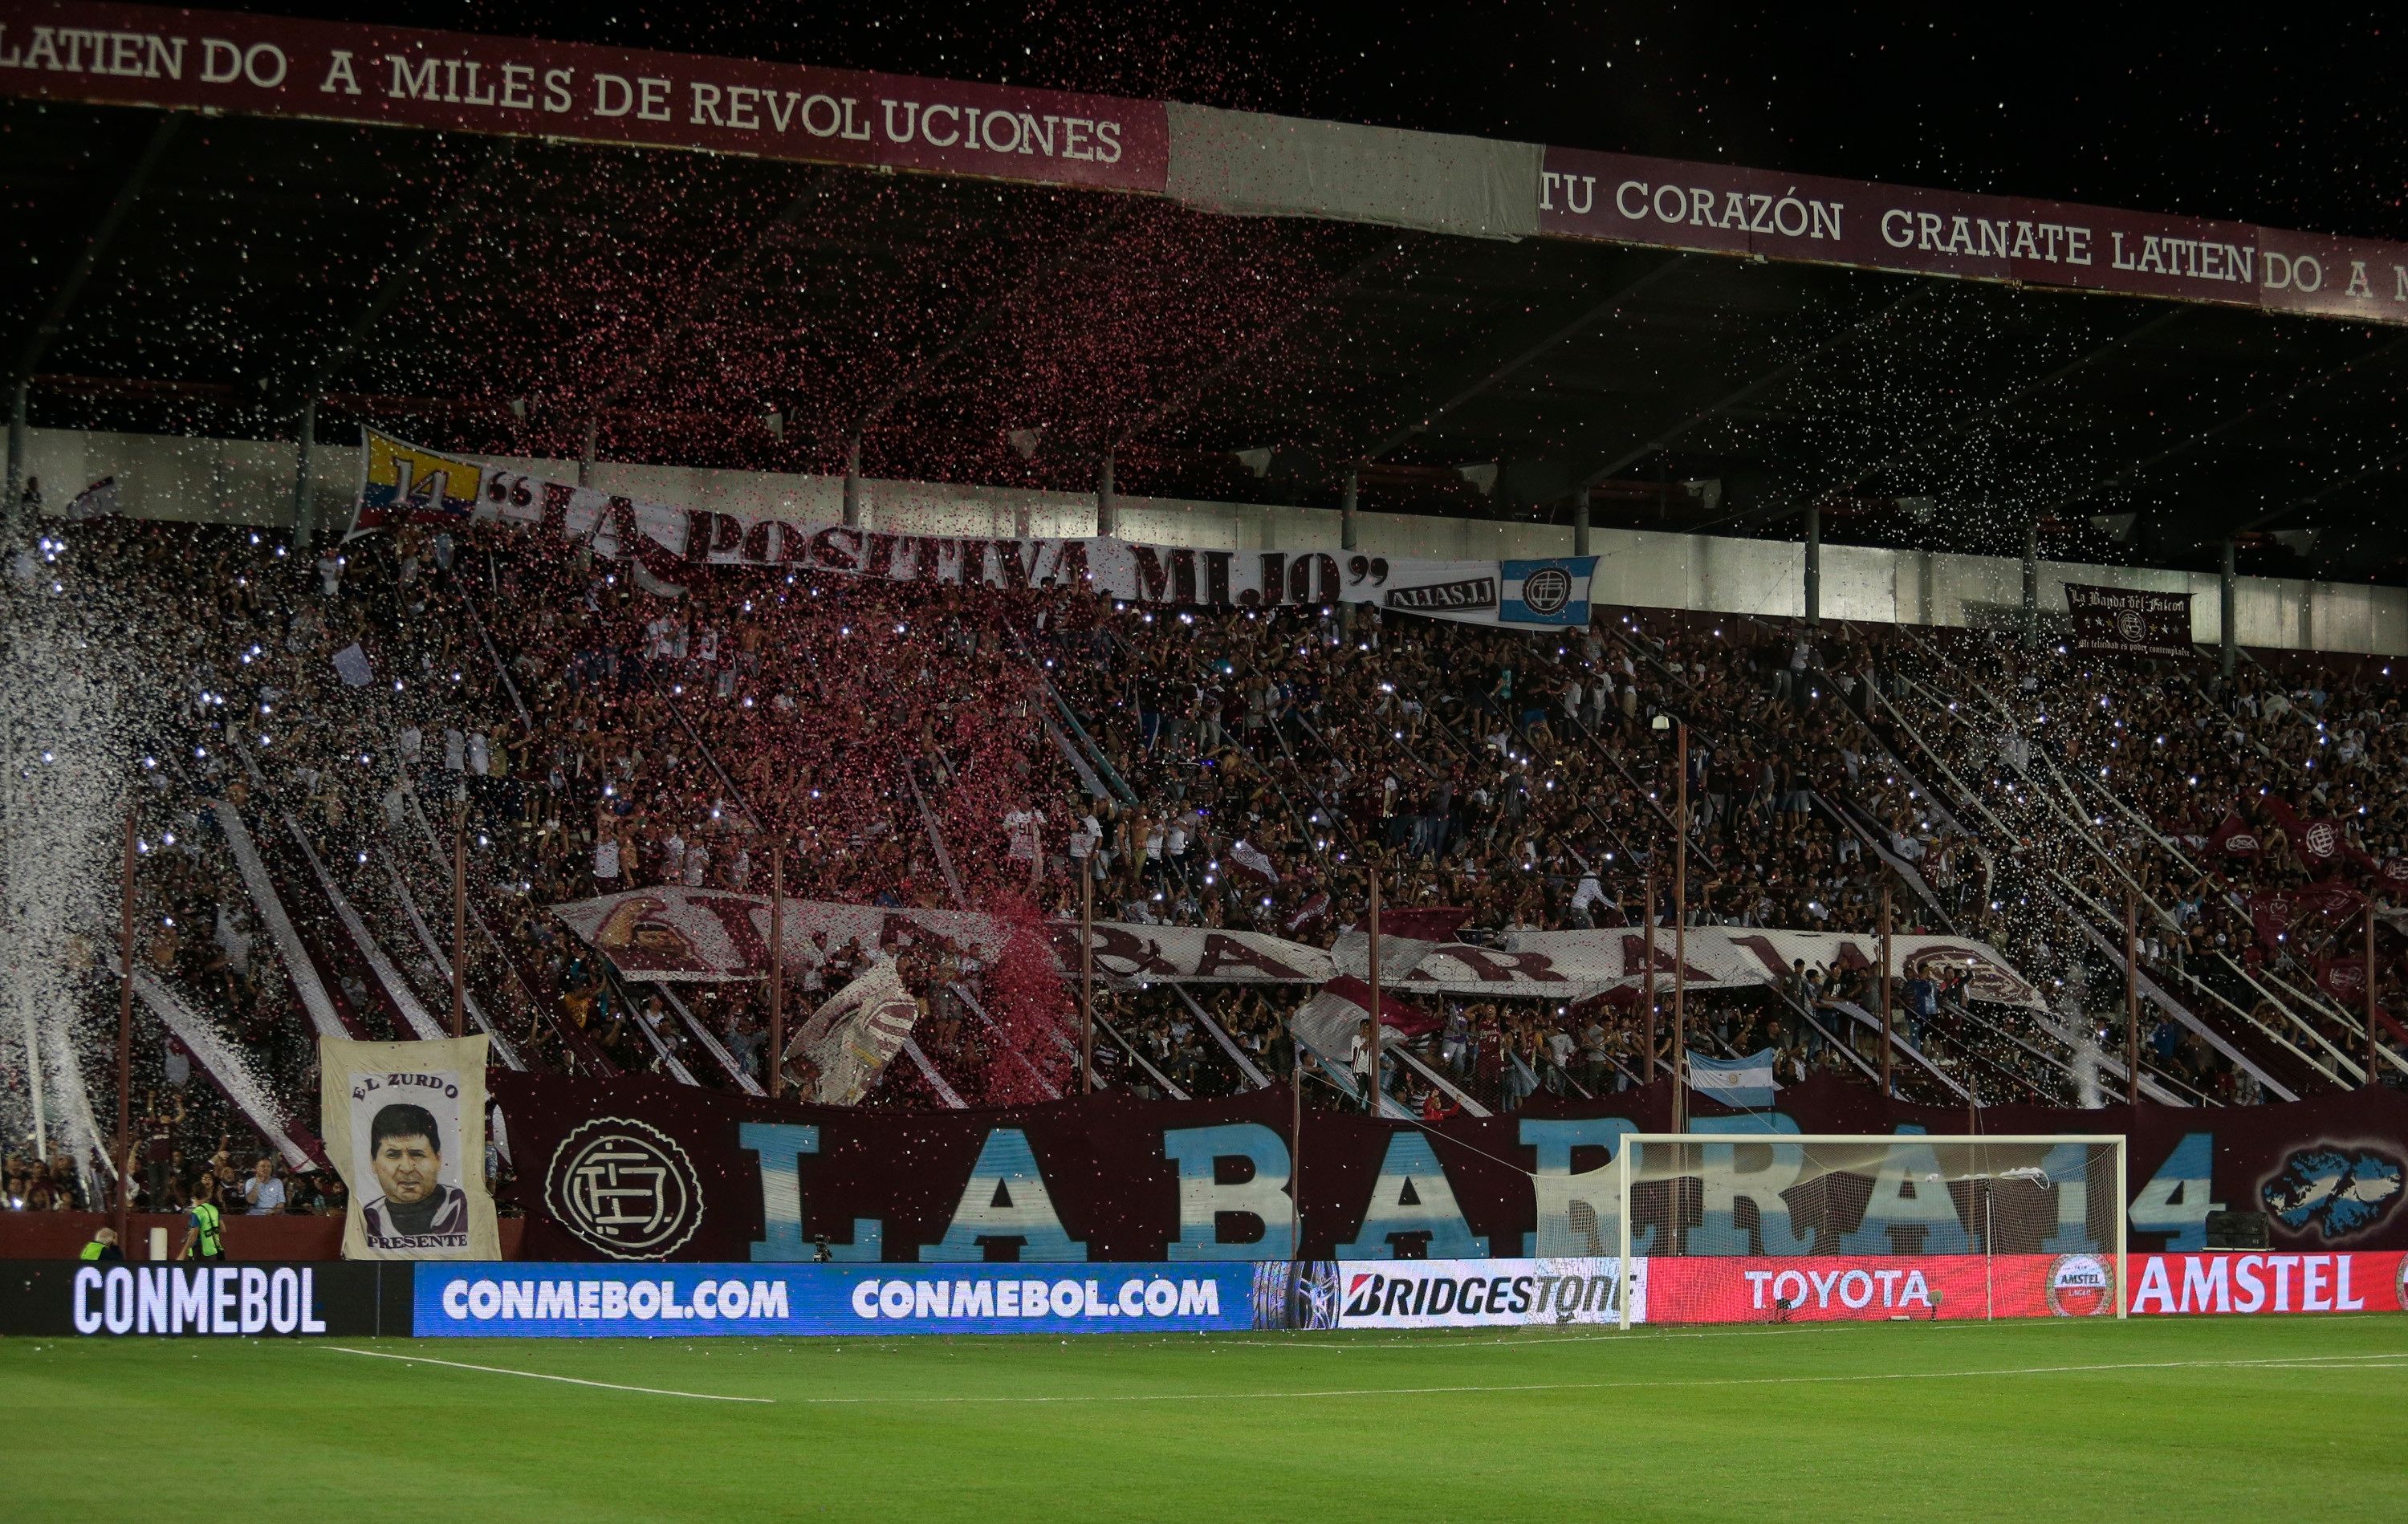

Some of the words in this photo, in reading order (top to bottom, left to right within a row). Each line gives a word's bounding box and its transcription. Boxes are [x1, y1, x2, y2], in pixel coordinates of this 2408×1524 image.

[321, 51, 361, 96] A
[388, 54, 572, 113] MILES
[594, 73, 671, 123] DE
[689, 82, 1121, 163] REVOLUCIONES
[1540, 171, 1597, 214] TU
[1615, 181, 1844, 241] CORAZÓN
[1881, 209, 2092, 266] GRANATE
[2345, 261, 2373, 299] A
[391, 457, 449, 512] 14
[2069, 588, 2086, 603] La
[2089, 591, 2126, 608] Banda
[2128, 595, 2144, 609] del
[352, 1077, 380, 1102] EL
[388, 1073, 458, 1099] ZURDO
[739, 1122, 1088, 1262] LA
[1164, 1112, 1983, 1262] BARRA
[2041, 1132, 2228, 1252] 14
[367, 1234, 468, 1250] PRESENTE
[73, 1266, 327, 1334] CONMEBOL
[441, 1279, 790, 1319] CONMEBOL.COM
[852, 1278, 1220, 1319] CONMEBOL.COM
[1744, 1269, 1932, 1310] TOYOTA
[2060, 1274, 2101, 1285] AMSTEL
[2130, 1254, 2365, 1314] AMSTEL
